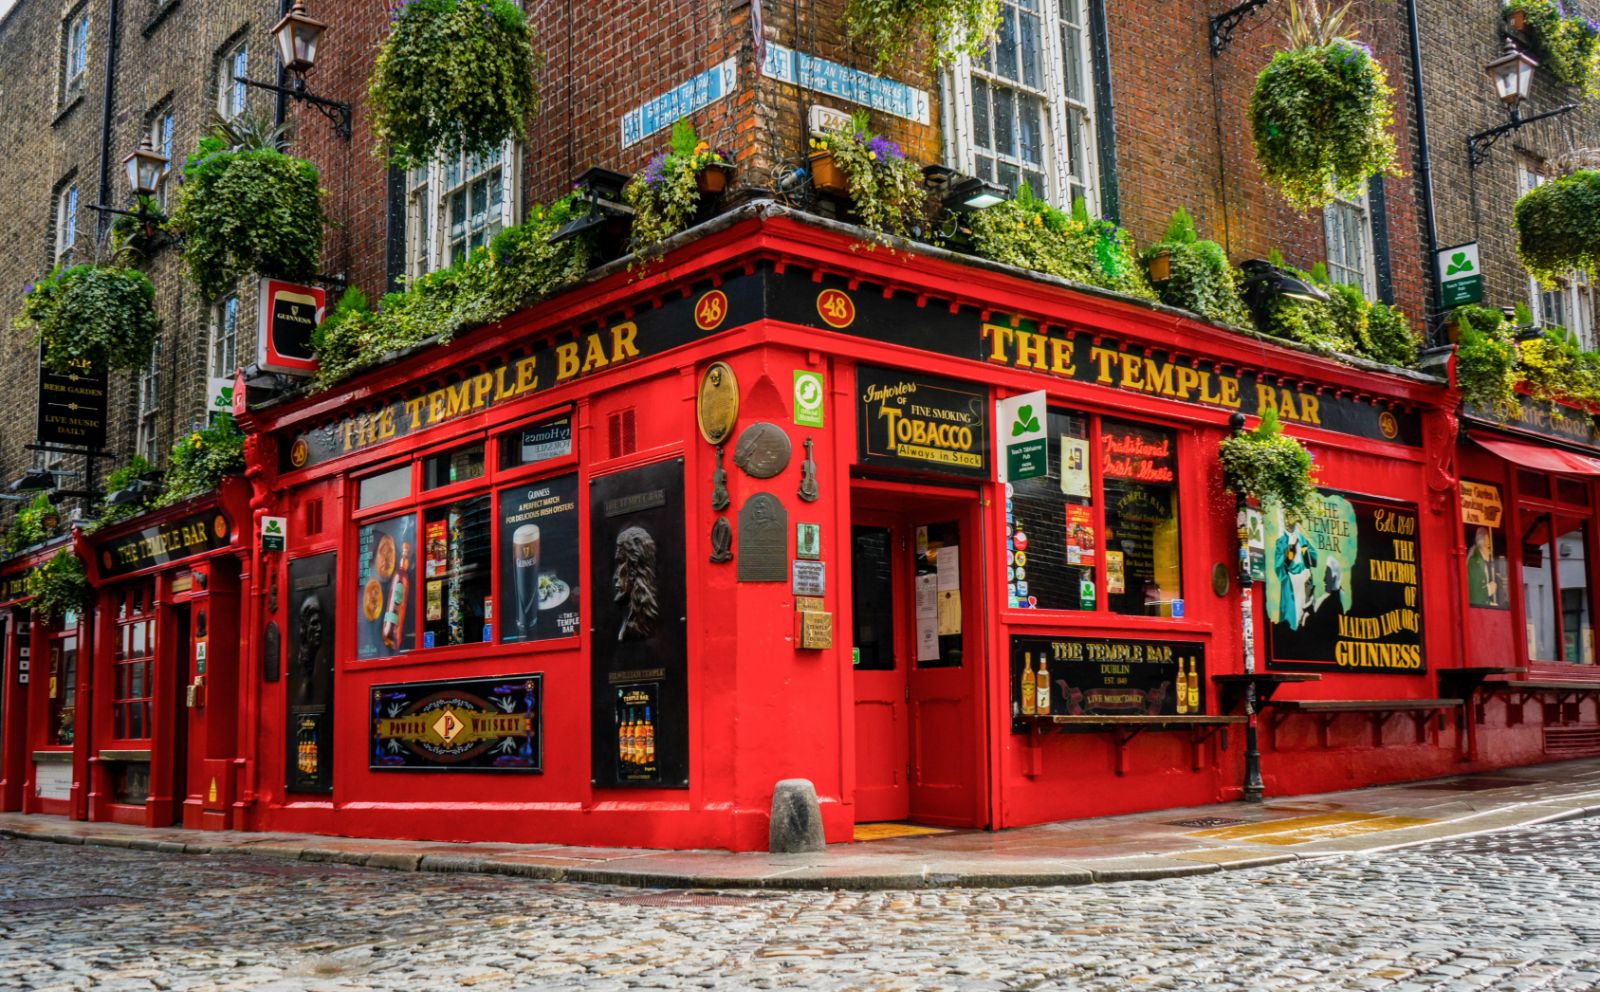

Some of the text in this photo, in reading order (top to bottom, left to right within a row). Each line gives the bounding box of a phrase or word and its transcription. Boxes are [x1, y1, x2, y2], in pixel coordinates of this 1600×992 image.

[726, 69, 733, 86] 2
[824, 67, 836, 78] AN
[799, 72, 906, 115] TEMPLE LANE SOUTH
[918, 100, 926, 116] 2
[277, 312, 312, 325] GUINNESS
[698, 295, 724, 327] 48
[822, 295, 847, 320] 48
[982, 323, 1321, 426] THE TEMPLE BAR
[43, 383, 104, 397] BEER GARDEN
[339, 319, 640, 453] THE TEMPLE BAR
[896, 396, 908, 406] OF
[45, 415, 100, 428] LIVE MUSIC
[911, 404, 972, 424] FINE SMOKING
[57, 426, 87, 436] DAILY
[878, 406, 973, 450] TOBACCO
[899, 443, 981, 466] Always in Stock
[1101, 433, 1169, 457] Traditional
[1102, 453, 1174, 482] Irish Music
[523, 500, 543, 511] PERFECT
[543, 495, 561, 506] MATCH
[527, 487, 551, 501] GUINNESS
[505, 502, 575, 525] FOR DELICIOUS IRISH OYSTERS
[1317, 499, 1339, 520] THE
[1306, 516, 1350, 538] TEMPLE
[118, 521, 209, 566] THE TEMPLE BAR
[1317, 534, 1342, 554] BAR
[1393, 538, 1416, 562] THE
[1369, 558, 1417, 585] EMPEROR
[9, 578, 23, 595] THE
[1404, 585, 1417, 608] OF
[557, 617, 580, 627] TEMPLE
[562, 625, 575, 634] BAR
[1338, 607, 1421, 641] MALTED LIQUORS
[1051, 641, 1174, 664] THE TEMPLE BAR
[1335, 640, 1421, 669] GUINNESS
[1100, 664, 1130, 675] DUBLIN
[1087, 694, 1103, 705] LIVE
[389, 714, 521, 738] POWERS P WHISKEY
